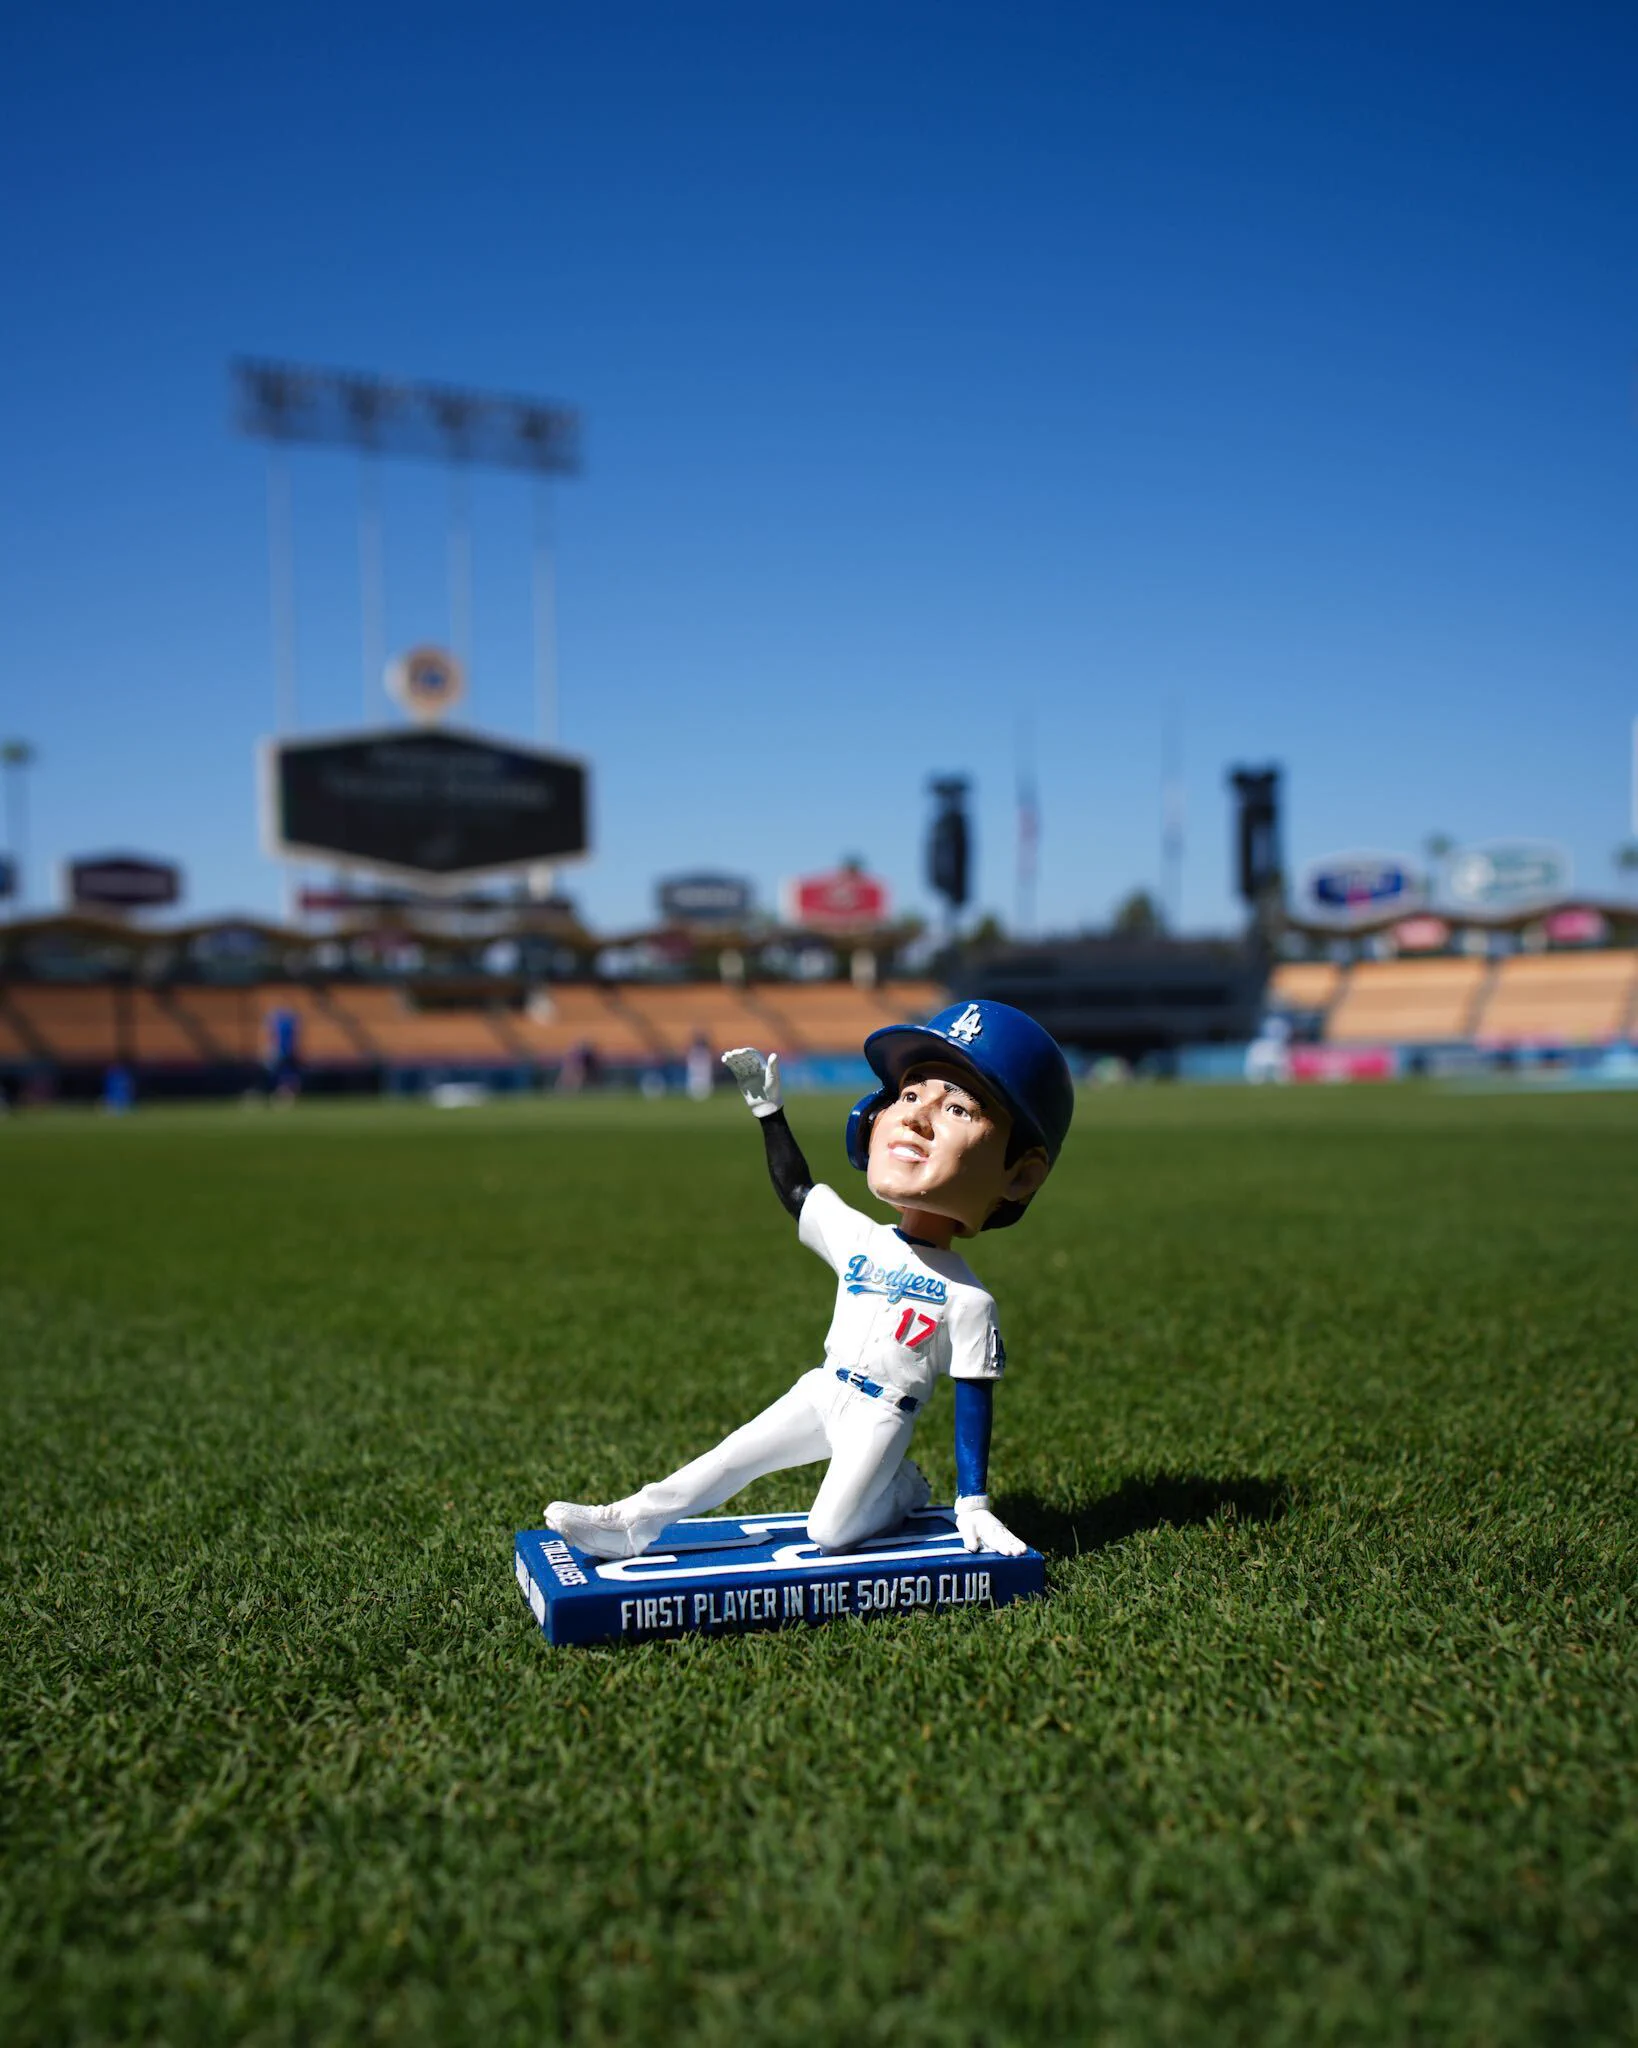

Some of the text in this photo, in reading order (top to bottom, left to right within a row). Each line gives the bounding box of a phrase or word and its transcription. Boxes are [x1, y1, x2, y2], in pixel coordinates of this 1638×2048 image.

[949, 1003, 981, 1042] LA
[844, 1254, 947, 1304] Dodgers
[895, 1307, 938, 1350] 17
[539, 1540, 589, 1586] STOLEN BASES
[620, 1571, 991, 1631] FIRST PLAYER IN THE 50/50 CLUB
